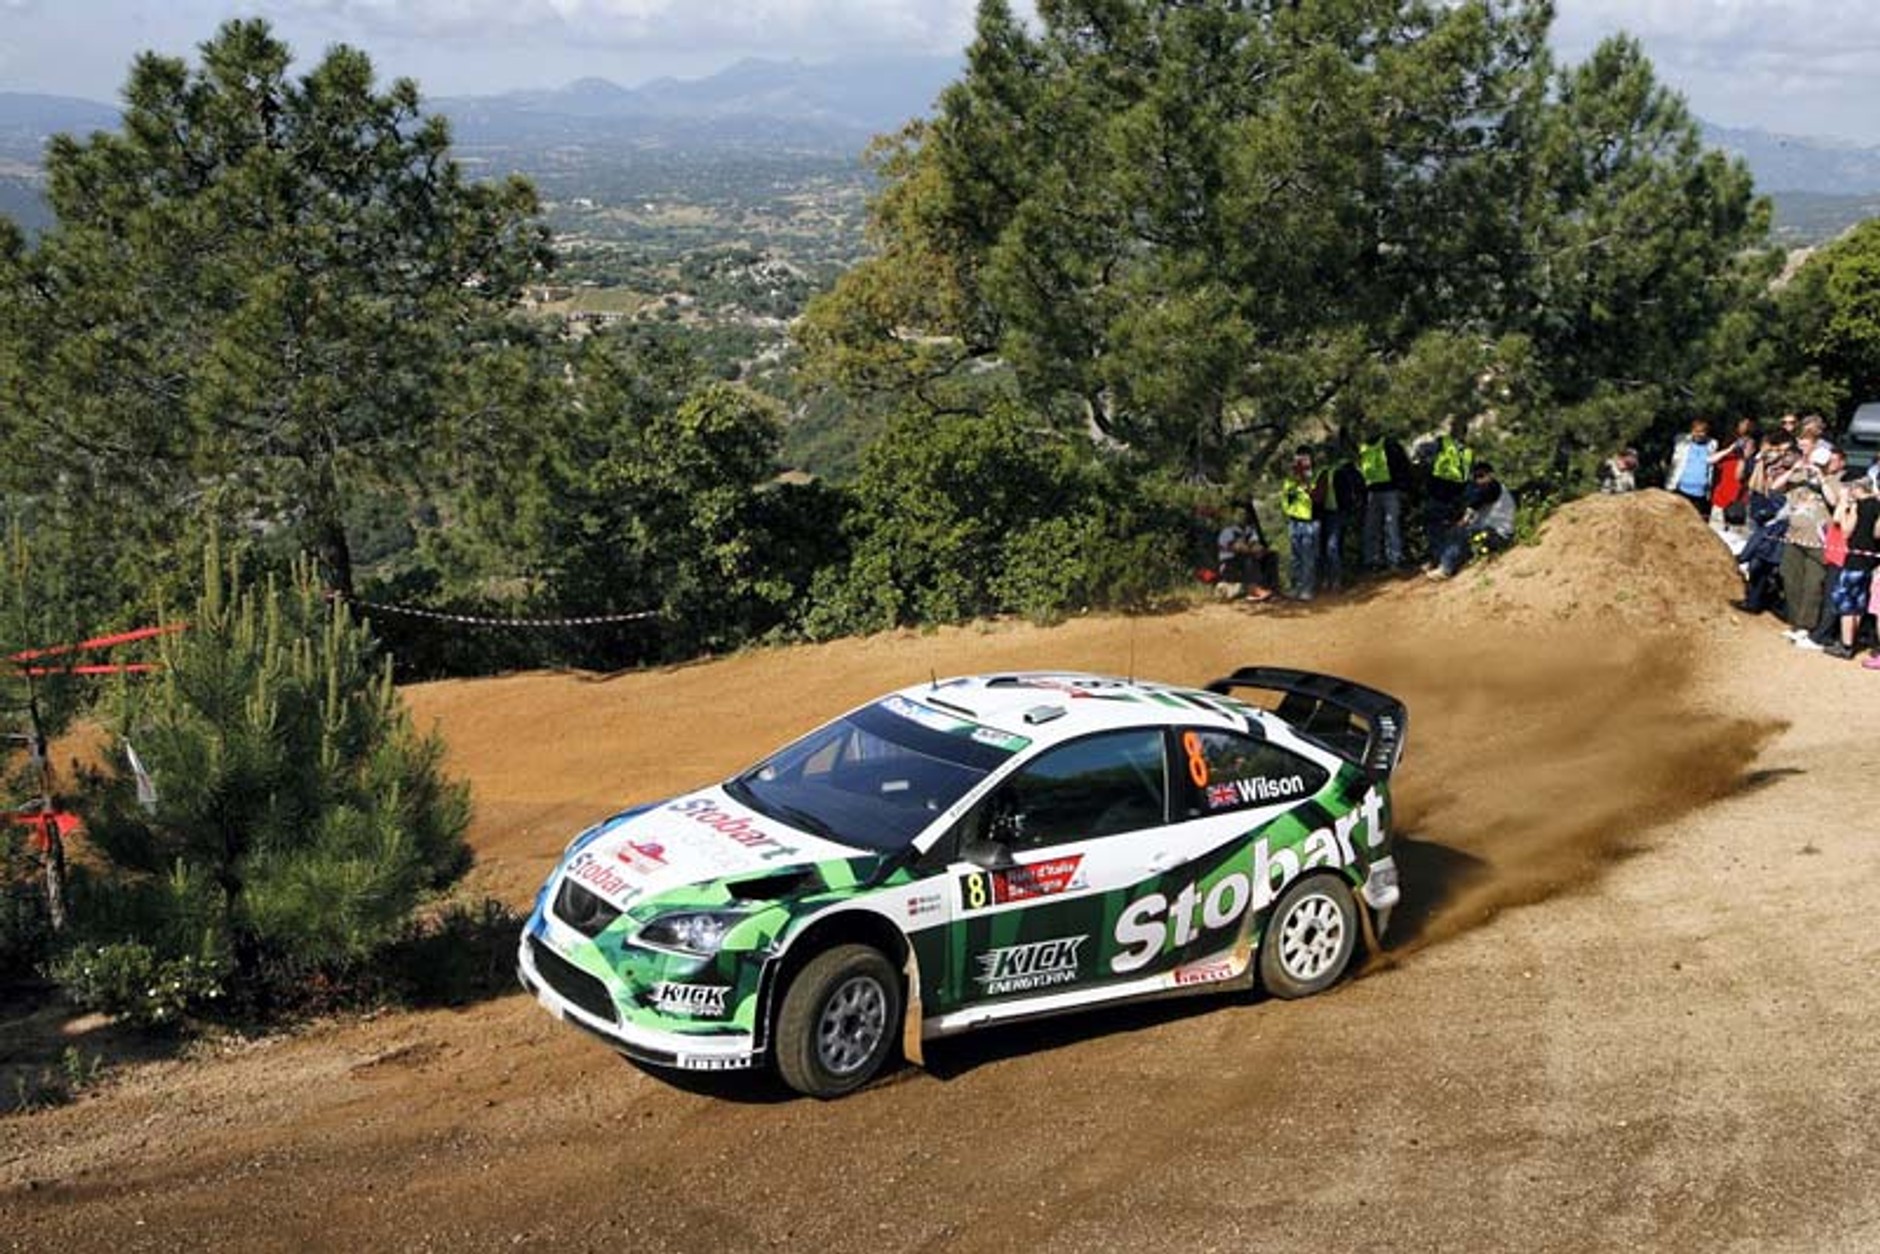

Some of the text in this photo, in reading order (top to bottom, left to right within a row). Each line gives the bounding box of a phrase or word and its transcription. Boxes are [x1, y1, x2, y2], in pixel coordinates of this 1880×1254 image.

[1183, 731, 1209, 788] 8
[1236, 775, 1304, 802] Wilson
[668, 798, 800, 861] Stobart
[567, 852, 643, 905] Stobart
[967, 871, 986, 909] 8
[1110, 785, 1385, 974] Stobart
[993, 939, 1082, 980] KICK
